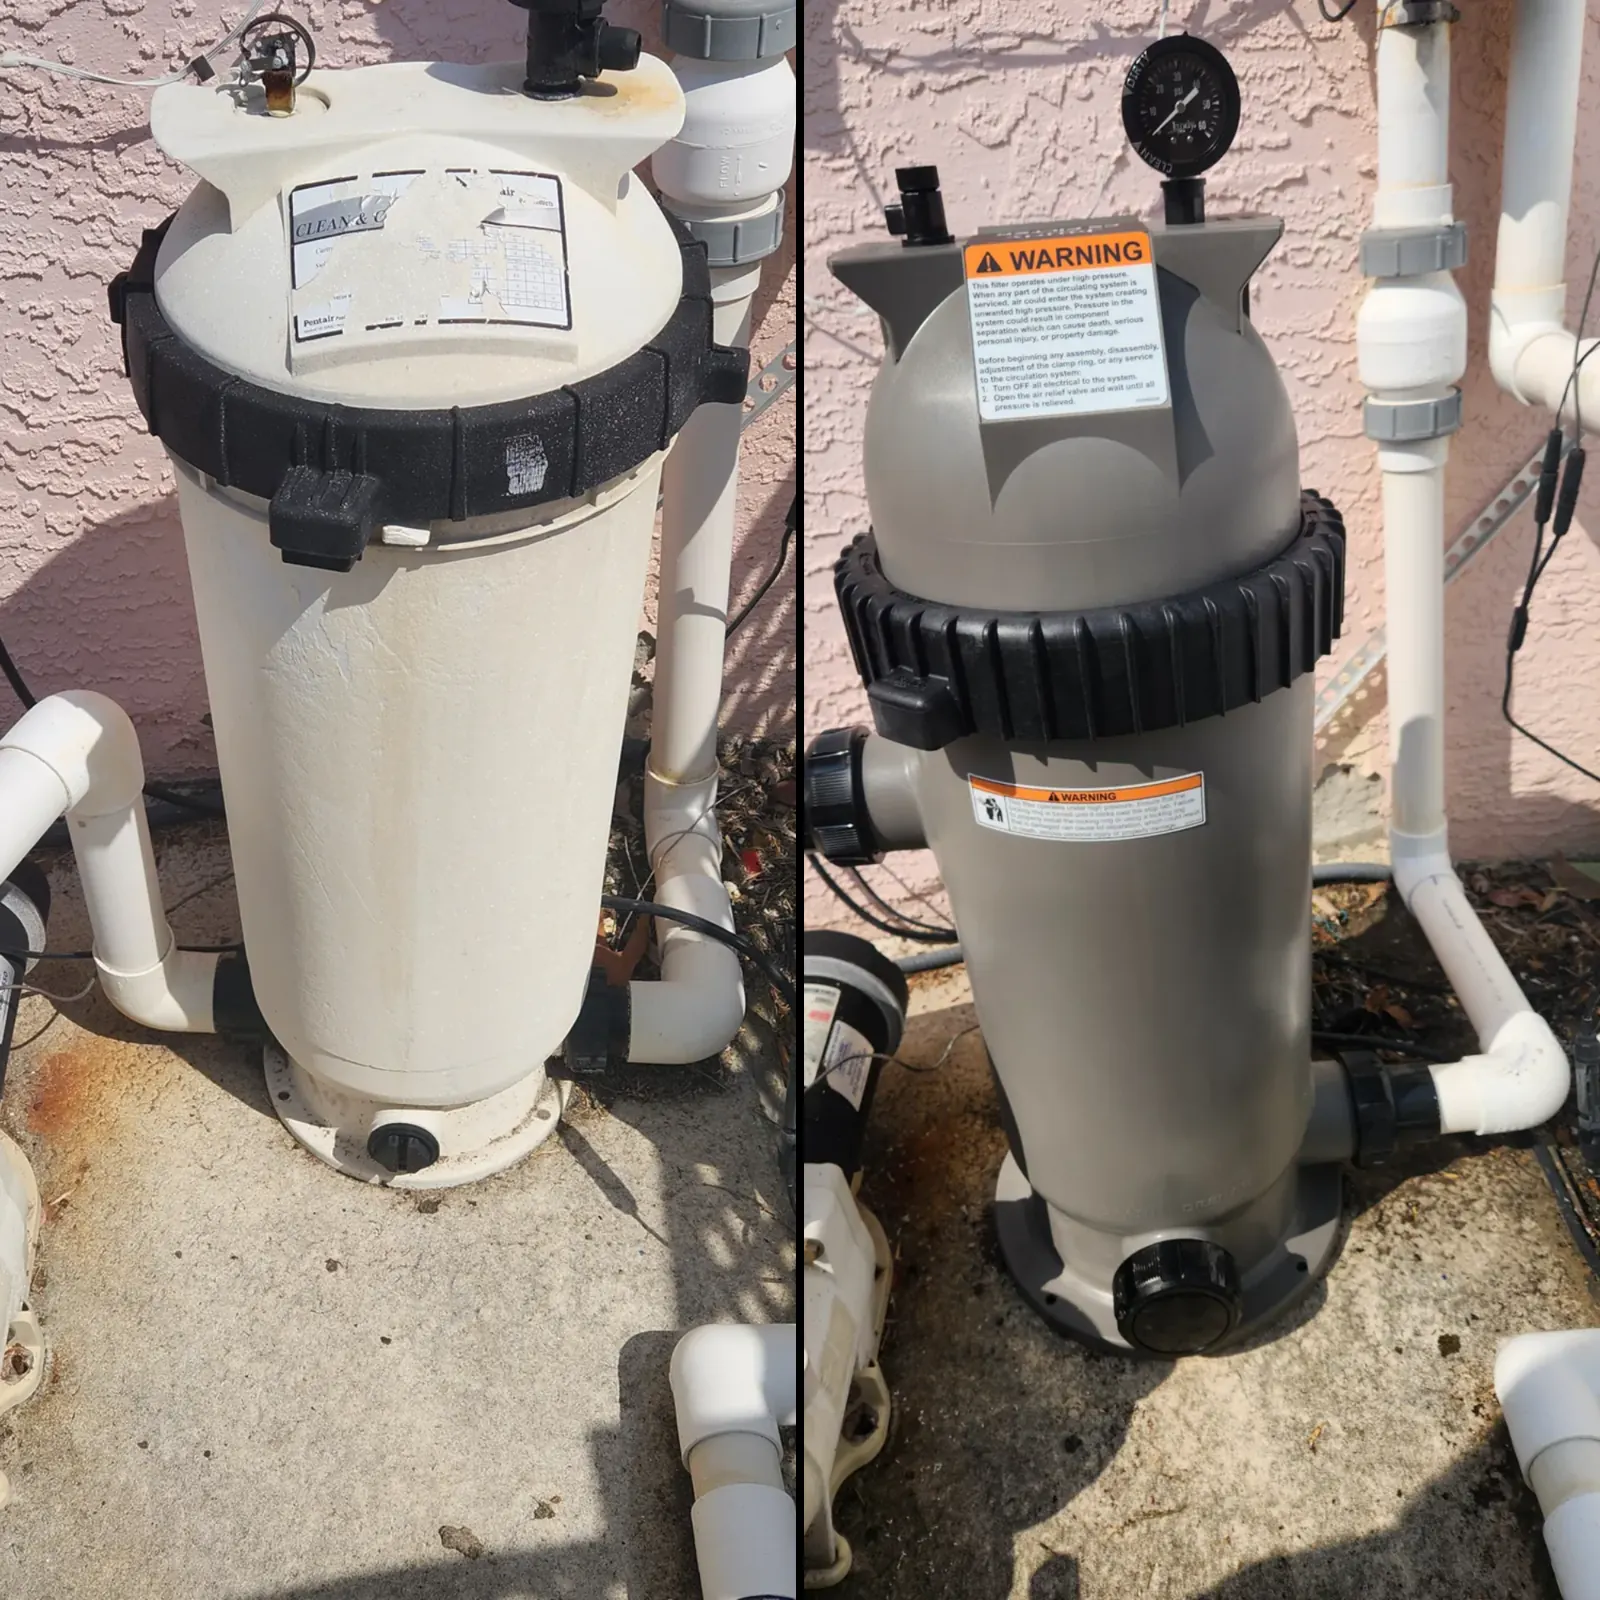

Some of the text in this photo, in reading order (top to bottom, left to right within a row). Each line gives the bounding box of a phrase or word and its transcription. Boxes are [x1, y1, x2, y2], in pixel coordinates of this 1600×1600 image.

[1126, 50, 1149, 88] DIRTY
[1140, 147, 1173, 174] CLEAN
[296, 214, 350, 238] CLEAN
[356, 211, 367, 225] &
[1009, 241, 1142, 271] WARNING
[1010, 278, 1046, 287] operates
[1046, 275, 1070, 283] under
[1055, 283, 1098, 292] circulating
[1099, 280, 1128, 289] system
[1023, 295, 1046, 304] could
[1084, 291, 1113, 300] system
[1114, 288, 1147, 296] creating
[974, 307, 1013, 317] unwanted
[1073, 301, 1109, 309] Pressure
[303, 315, 334, 327] Pentair
[974, 319, 1004, 328] system
[1005, 316, 1029, 324] could
[1029, 314, 1053, 322] result
[1064, 309, 1109, 320] component
[975, 327, 1019, 337] separation
[1020, 324, 1044, 332] which
[1062, 321, 1086, 329] cause
[1114, 316, 1144, 324] serious
[976, 336, 1012, 347] personal
[1050, 331, 1085, 340] property
[977, 356, 1006, 364] Before
[1006, 352, 1048, 362] beginning
[979, 363, 1024, 374] adjustment
[1050, 360, 1076, 368] clamp
[1124, 353, 1153, 361] service
[1004, 372, 1048, 381] circulation
[1042, 377, 1080, 387] electrical
[992, 394, 1016, 402] Open
[994, 402, 1031, 412] pressure
[1061, 791, 1117, 802] WARNING
